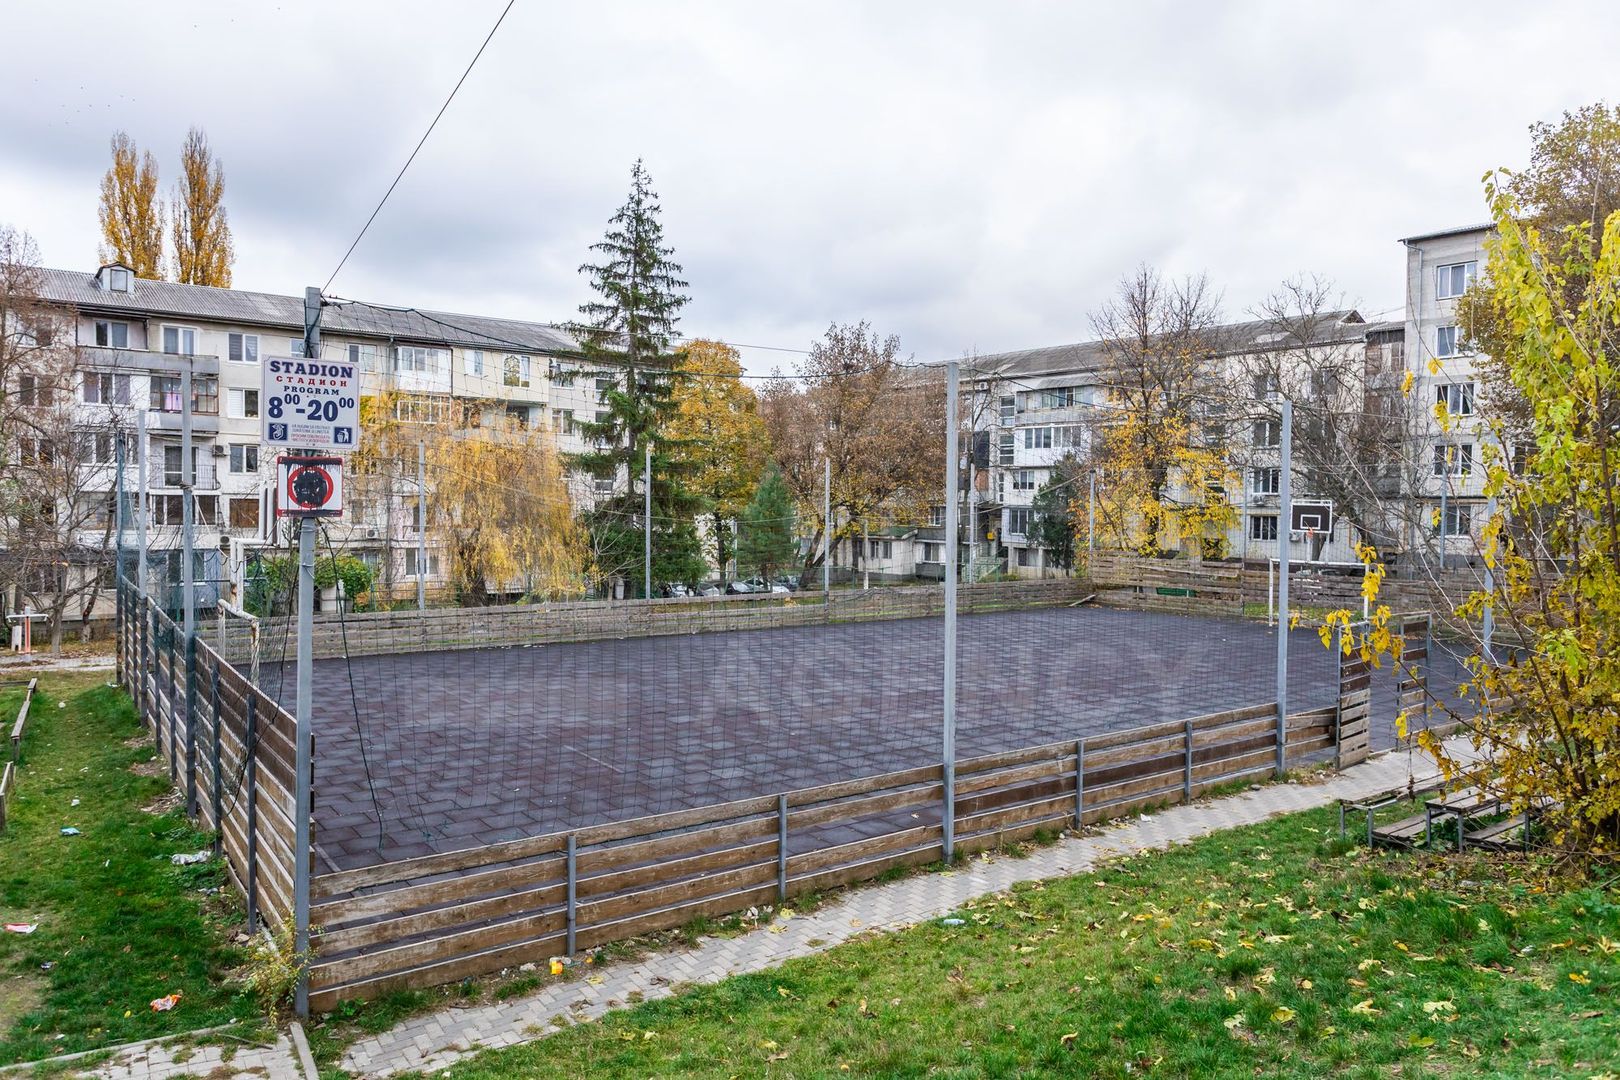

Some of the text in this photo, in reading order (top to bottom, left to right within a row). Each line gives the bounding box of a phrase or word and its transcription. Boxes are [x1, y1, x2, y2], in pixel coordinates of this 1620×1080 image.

[270, 360, 353, 378] STADION
[276, 376, 347, 387] СТАДИОН
[283, 385, 339, 396] PROGRAM
